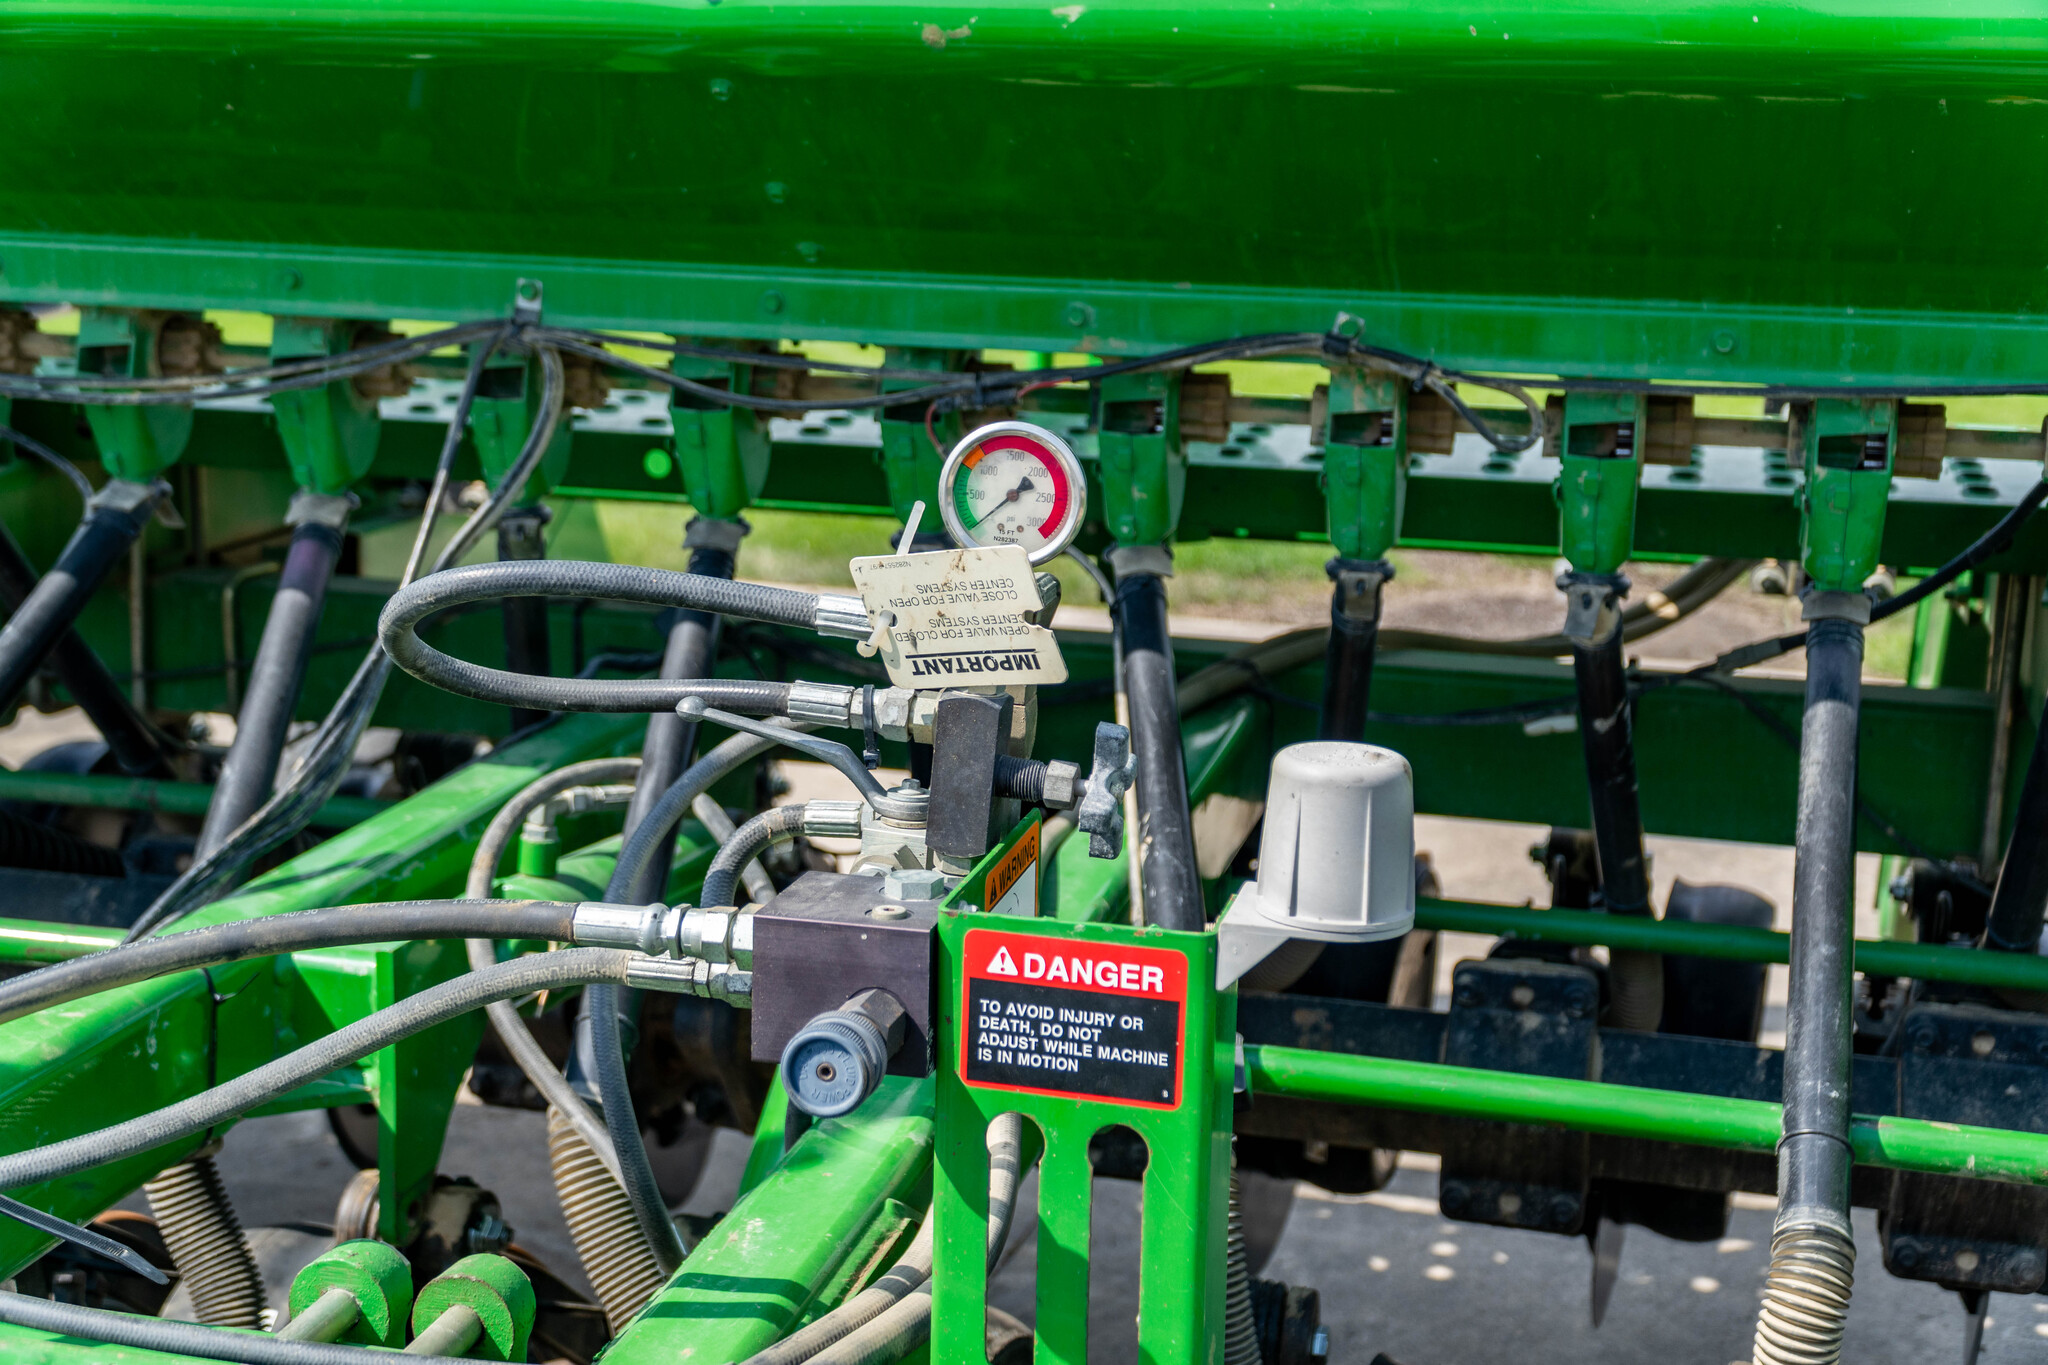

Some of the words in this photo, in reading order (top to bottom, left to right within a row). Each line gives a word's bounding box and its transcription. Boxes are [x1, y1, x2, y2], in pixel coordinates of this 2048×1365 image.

[1027, 467, 1049, 478] 2000
[969, 489, 985, 500] 500
[1036, 492, 1055, 503] 2500
[1006, 515, 1016, 523] psi
[971, 578, 1014, 590] CENTER
[924, 595, 944, 605] FOR
[949, 592, 983, 604] VALVE
[985, 590, 1018, 600] CLOSE
[889, 598, 919, 607] OPEN
[929, 617, 979, 628] SYSTEMS
[982, 613, 1023, 625] CENTER
[940, 629, 962, 639] FOR
[966, 627, 999, 637] VALVE
[1000, 625, 1030, 635] OPEN
[895, 630, 938, 642] CLOSED
[911, 654, 1041, 676] IMPORTANT
[998, 835, 1035, 894] WARNING
[1023, 952, 1164, 993] DANGER
[980, 999, 1001, 1014] TO
[1006, 1002, 1054, 1020] AVOID
[1059, 1008, 1115, 1028] INJURY
[1120, 1015, 1143, 1031] OR
[979, 1015, 1034, 1036] DEATH,
[1040, 1022, 1063, 1038] DO
[1068, 1026, 1102, 1042] NOT
[978, 1032, 1038, 1050] ADJUST
[1043, 1039, 1093, 1057] WHILE
[1097, 1046, 1168, 1067] MACHINE
[978, 1047, 992, 1061] IS
[997, 1050, 1012, 1064] IN
[1017, 1053, 1079, 1072] MOTION
